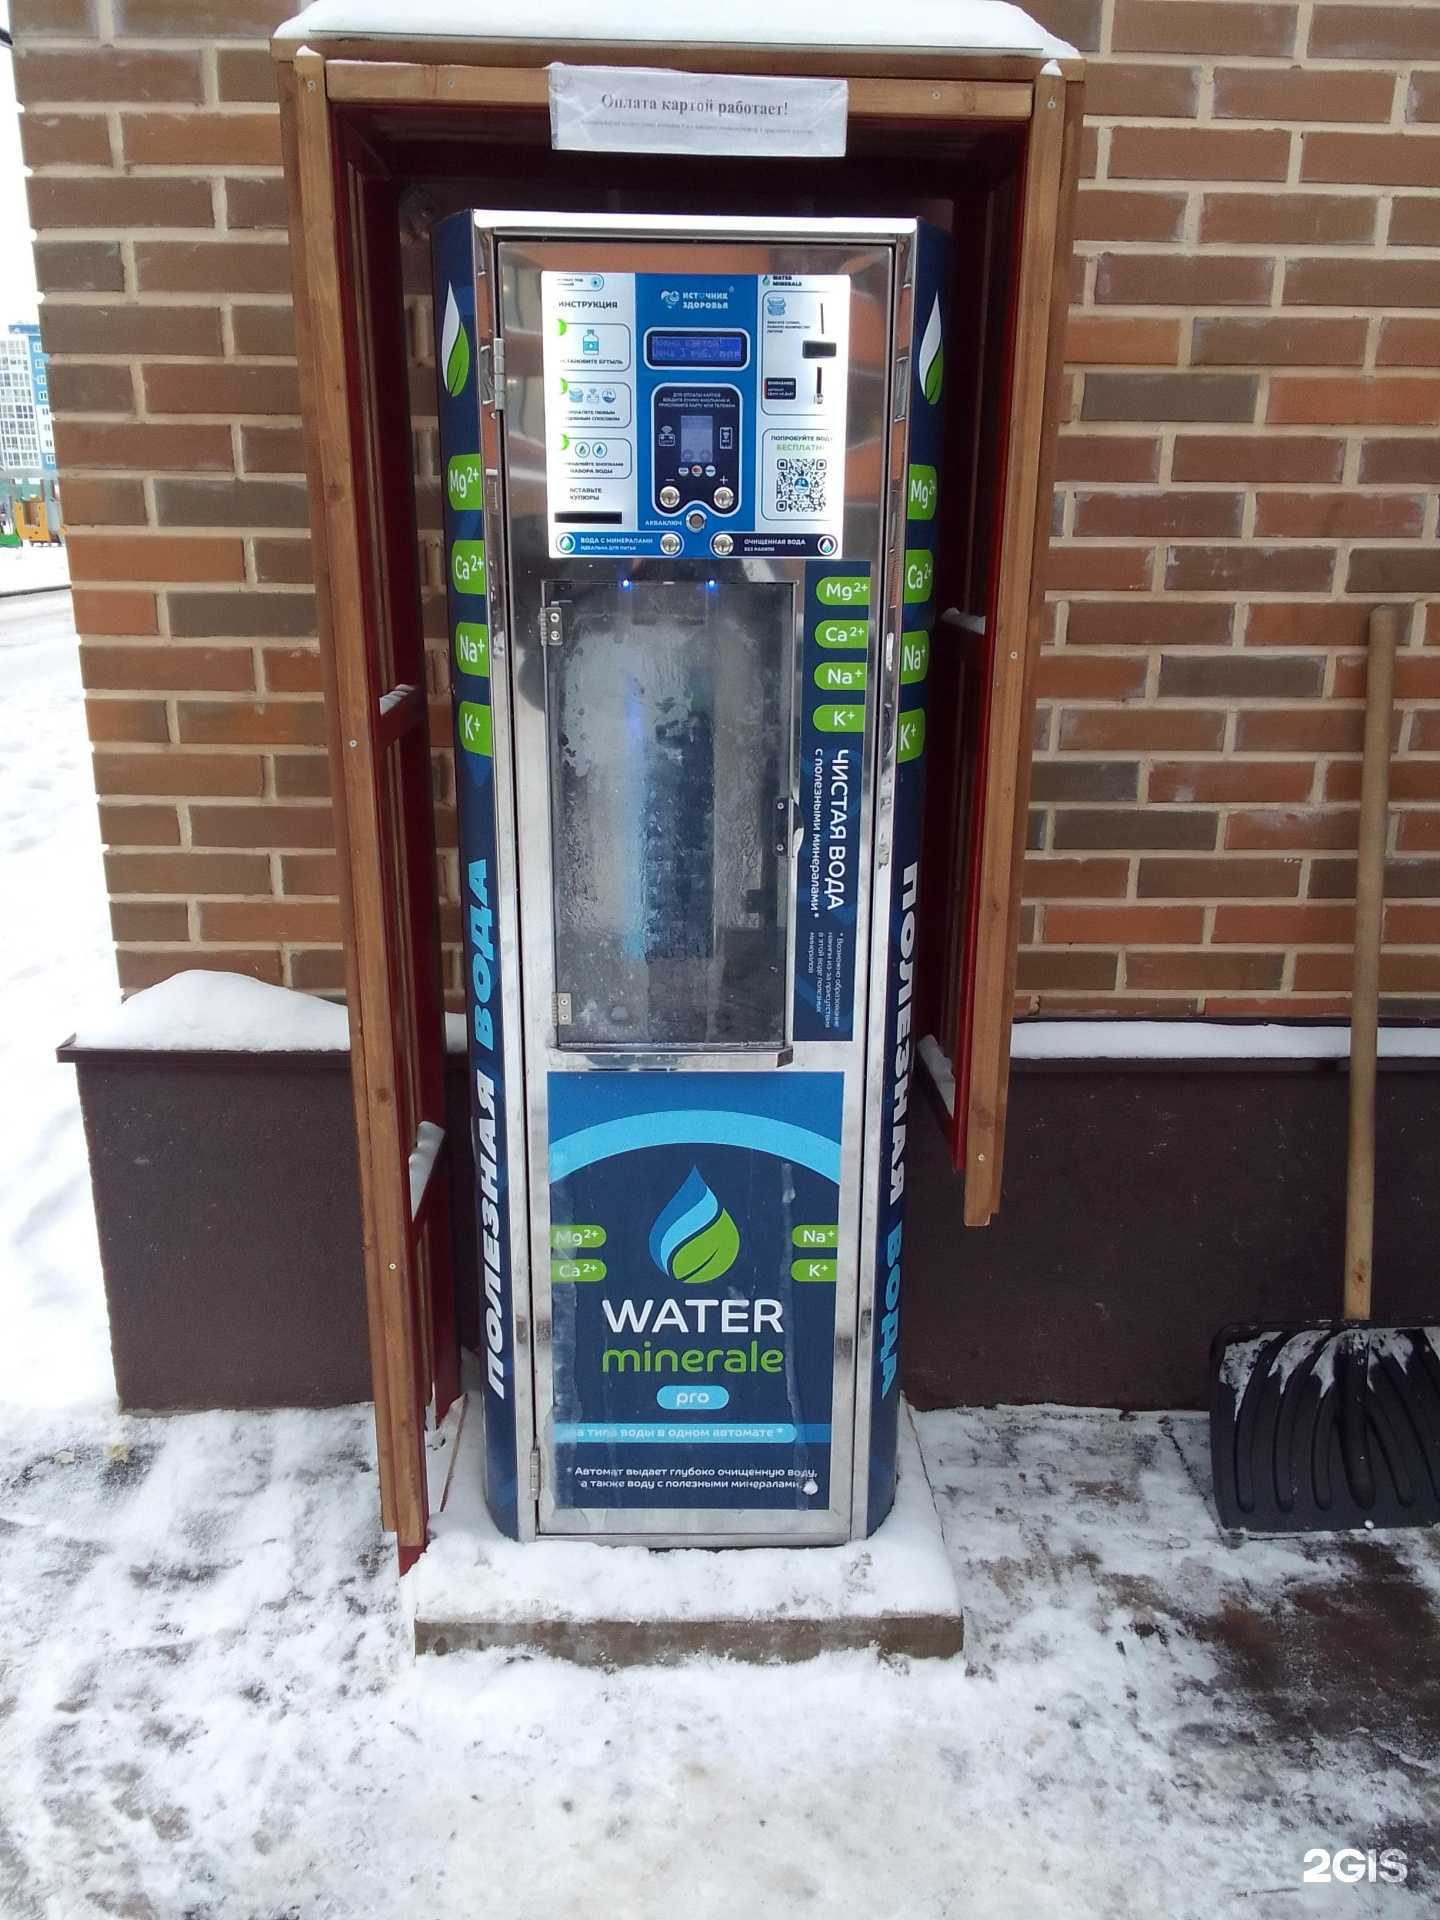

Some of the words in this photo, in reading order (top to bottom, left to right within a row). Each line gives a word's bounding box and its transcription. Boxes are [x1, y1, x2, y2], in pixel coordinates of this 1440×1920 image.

[601, 93, 657, 110] Оплата
[662, 97, 714, 115] картой
[718, 100, 788, 116] работает!
[558, 301, 618, 309] ИНСТРУКЦИЯ
[812, 758, 823, 831] полезными
[829, 749, 849, 839] ЧИСТАЯ
[824, 846, 846, 910] ВОДА
[468, 859, 494, 1051] ВОДА
[890, 862, 917, 1206] ПОЛЕЗНАЯ
[477, 1069, 505, 1400] ПОЛЕЗНАЯ
[601, 1299, 784, 1333] WATER
[880, 1220, 902, 1400] ВОДА
[602, 1341, 784, 1373] minerale
[676, 1391, 710, 1406] pro
[621, 1429, 655, 1439] воды
[658, 1429, 665, 1437] в
[668, 1429, 709, 1438] одном
[575, 1467, 623, 1476] Автомат
[626, 1468, 667, 1478] выдает
[670, 1467, 715, 1478] глубоко
[717, 1468, 785, 1478] очищенную
[627, 1481, 655, 1490] воду
[666, 1481, 728, 1489] полезными
